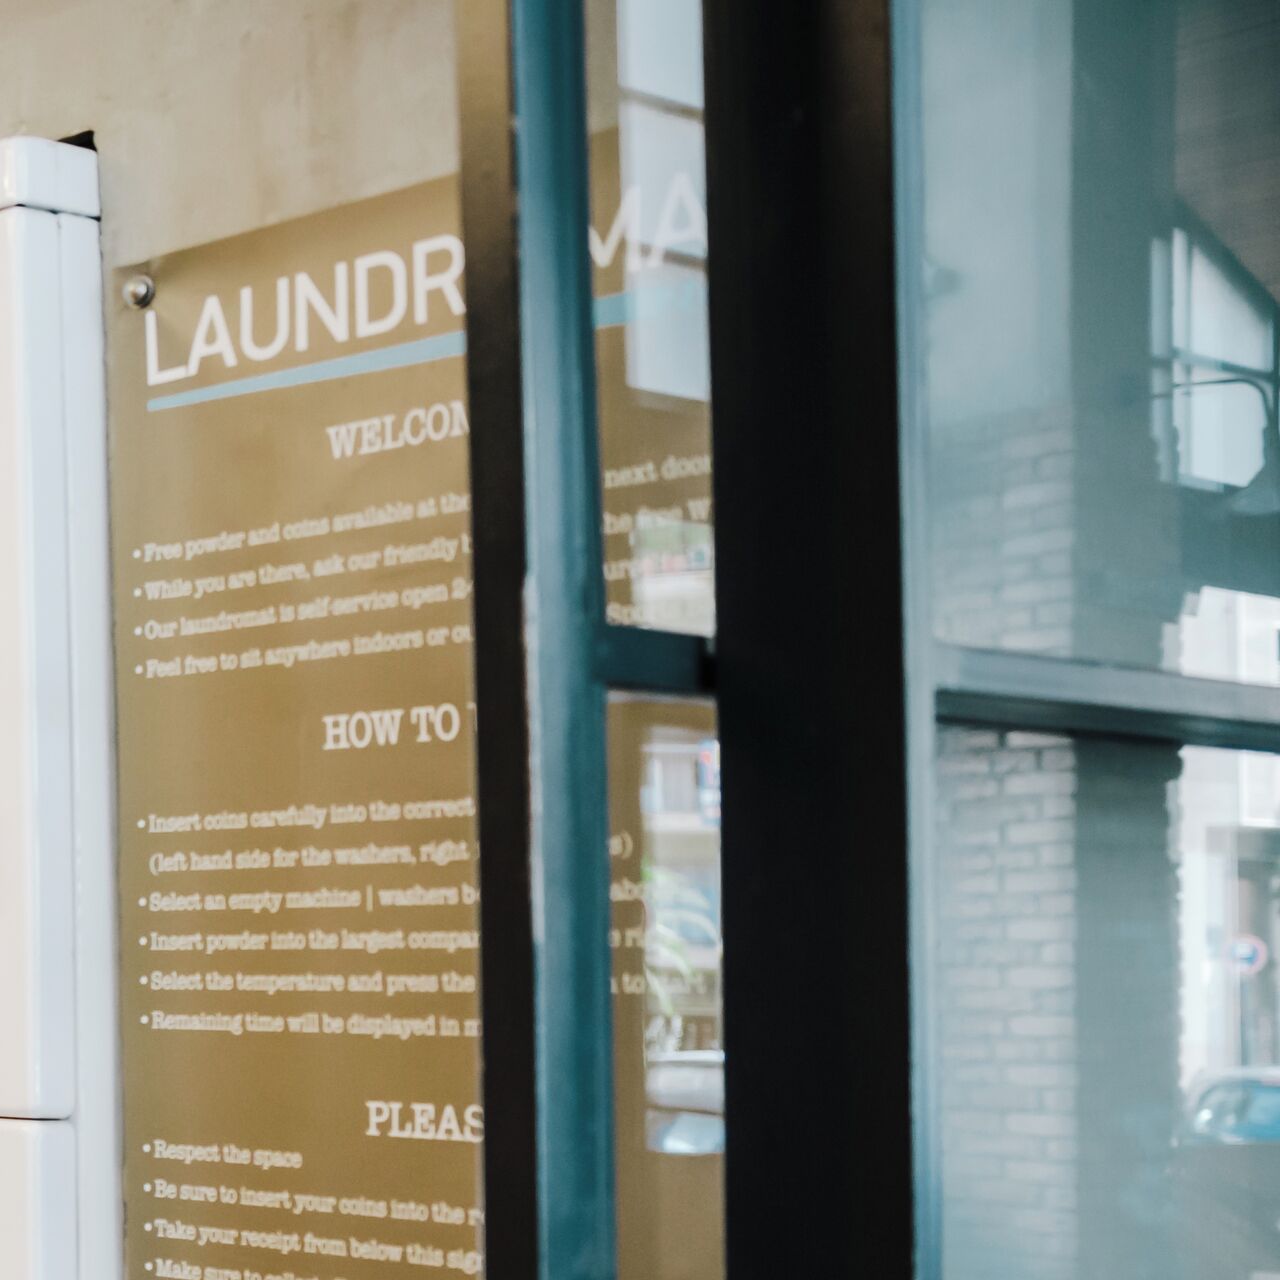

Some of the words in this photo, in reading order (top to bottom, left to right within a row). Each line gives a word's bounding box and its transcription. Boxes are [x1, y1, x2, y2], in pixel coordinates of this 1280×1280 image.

[143, 542, 182, 563] Free
[185, 531, 246, 560] powder
[248, 522, 280, 545] and
[283, 517, 330, 541] coins
[332, 501, 414, 532] available
[417, 497, 436, 518] at
[144, 576, 192, 600] While
[194, 575, 225, 599] you
[228, 569, 256, 588] are
[258, 560, 310, 585] there,
[313, 554, 345, 577] ask
[347, 550, 380, 572] our
[383, 535, 458, 567] friendly
[144, 618, 178, 640] Our
[180, 604, 276, 636] laundromat
[279, 602, 295, 622] is
[401, 583, 448, 609] open
[146, 656, 182, 679] Feel
[184, 652, 218, 675] free
[219, 650, 238, 670] to
[240, 647, 263, 668] sit
[264, 638, 351, 668] anywhere
[352, 628, 423, 655] indoors
[425, 625, 449, 647] or
[322, 708, 404, 751] HOW
[410, 702, 460, 743] TO
[148, 811, 201, 833] Insert
[203, 809, 248, 831] coins
[250, 802, 328, 830] carefully
[330, 803, 367, 824] into
[369, 799, 401, 821] the
[403, 795, 476, 820] correct
[149, 850, 188, 876] (left
[190, 849, 233, 871] hand
[235, 846, 270, 869] side
[272, 846, 300, 867] for
[301, 846, 332, 867] the
[334, 843, 417, 867] washers,
[419, 838, 471, 866] right
[149, 890, 201, 912] Select
[203, 894, 226, 911] an
[228, 891, 283, 914] empty
[285, 887, 361, 909] machine
[378, 883, 458, 906] washers
[149, 931, 203, 952] Insert
[206, 929, 270, 955] powder
[271, 930, 306, 950] into
[308, 928, 339, 950] the
[341, 929, 406, 954] largest
[150, 970, 203, 991] Select
[205, 971, 234, 991] the
[236, 970, 345, 996] temperature
[347, 970, 383, 992] and
[386, 974, 439, 996] press
[442, 970, 476, 993] the
[151, 1010, 243, 1035] Remaining
[245, 1012, 285, 1033] time
[287, 1011, 320, 1033] will
[322, 1013, 344, 1034] be
[346, 1013, 435, 1040] displayed
[439, 1016, 460, 1037] in
[153, 1138, 221, 1165] Respect
[223, 1146, 251, 1166] the
[253, 1149, 303, 1171] space
[153, 1178, 177, 1200] Be
[179, 1182, 218, 1203] sure
[220, 1185, 238, 1204] to
[239, 1186, 291, 1210] insert
[293, 1192, 337, 1215] your
[339, 1196, 387, 1219] coins
[389, 1200, 429, 1223] into
[431, 1201, 465, 1226] the
[153, 1218, 195, 1242] Take
[198, 1224, 238, 1246] your
[240, 1229, 301, 1255] receipt
[303, 1231, 347, 1257] from
[349, 1237, 403, 1263] below
[406, 1243, 444, 1268] this
